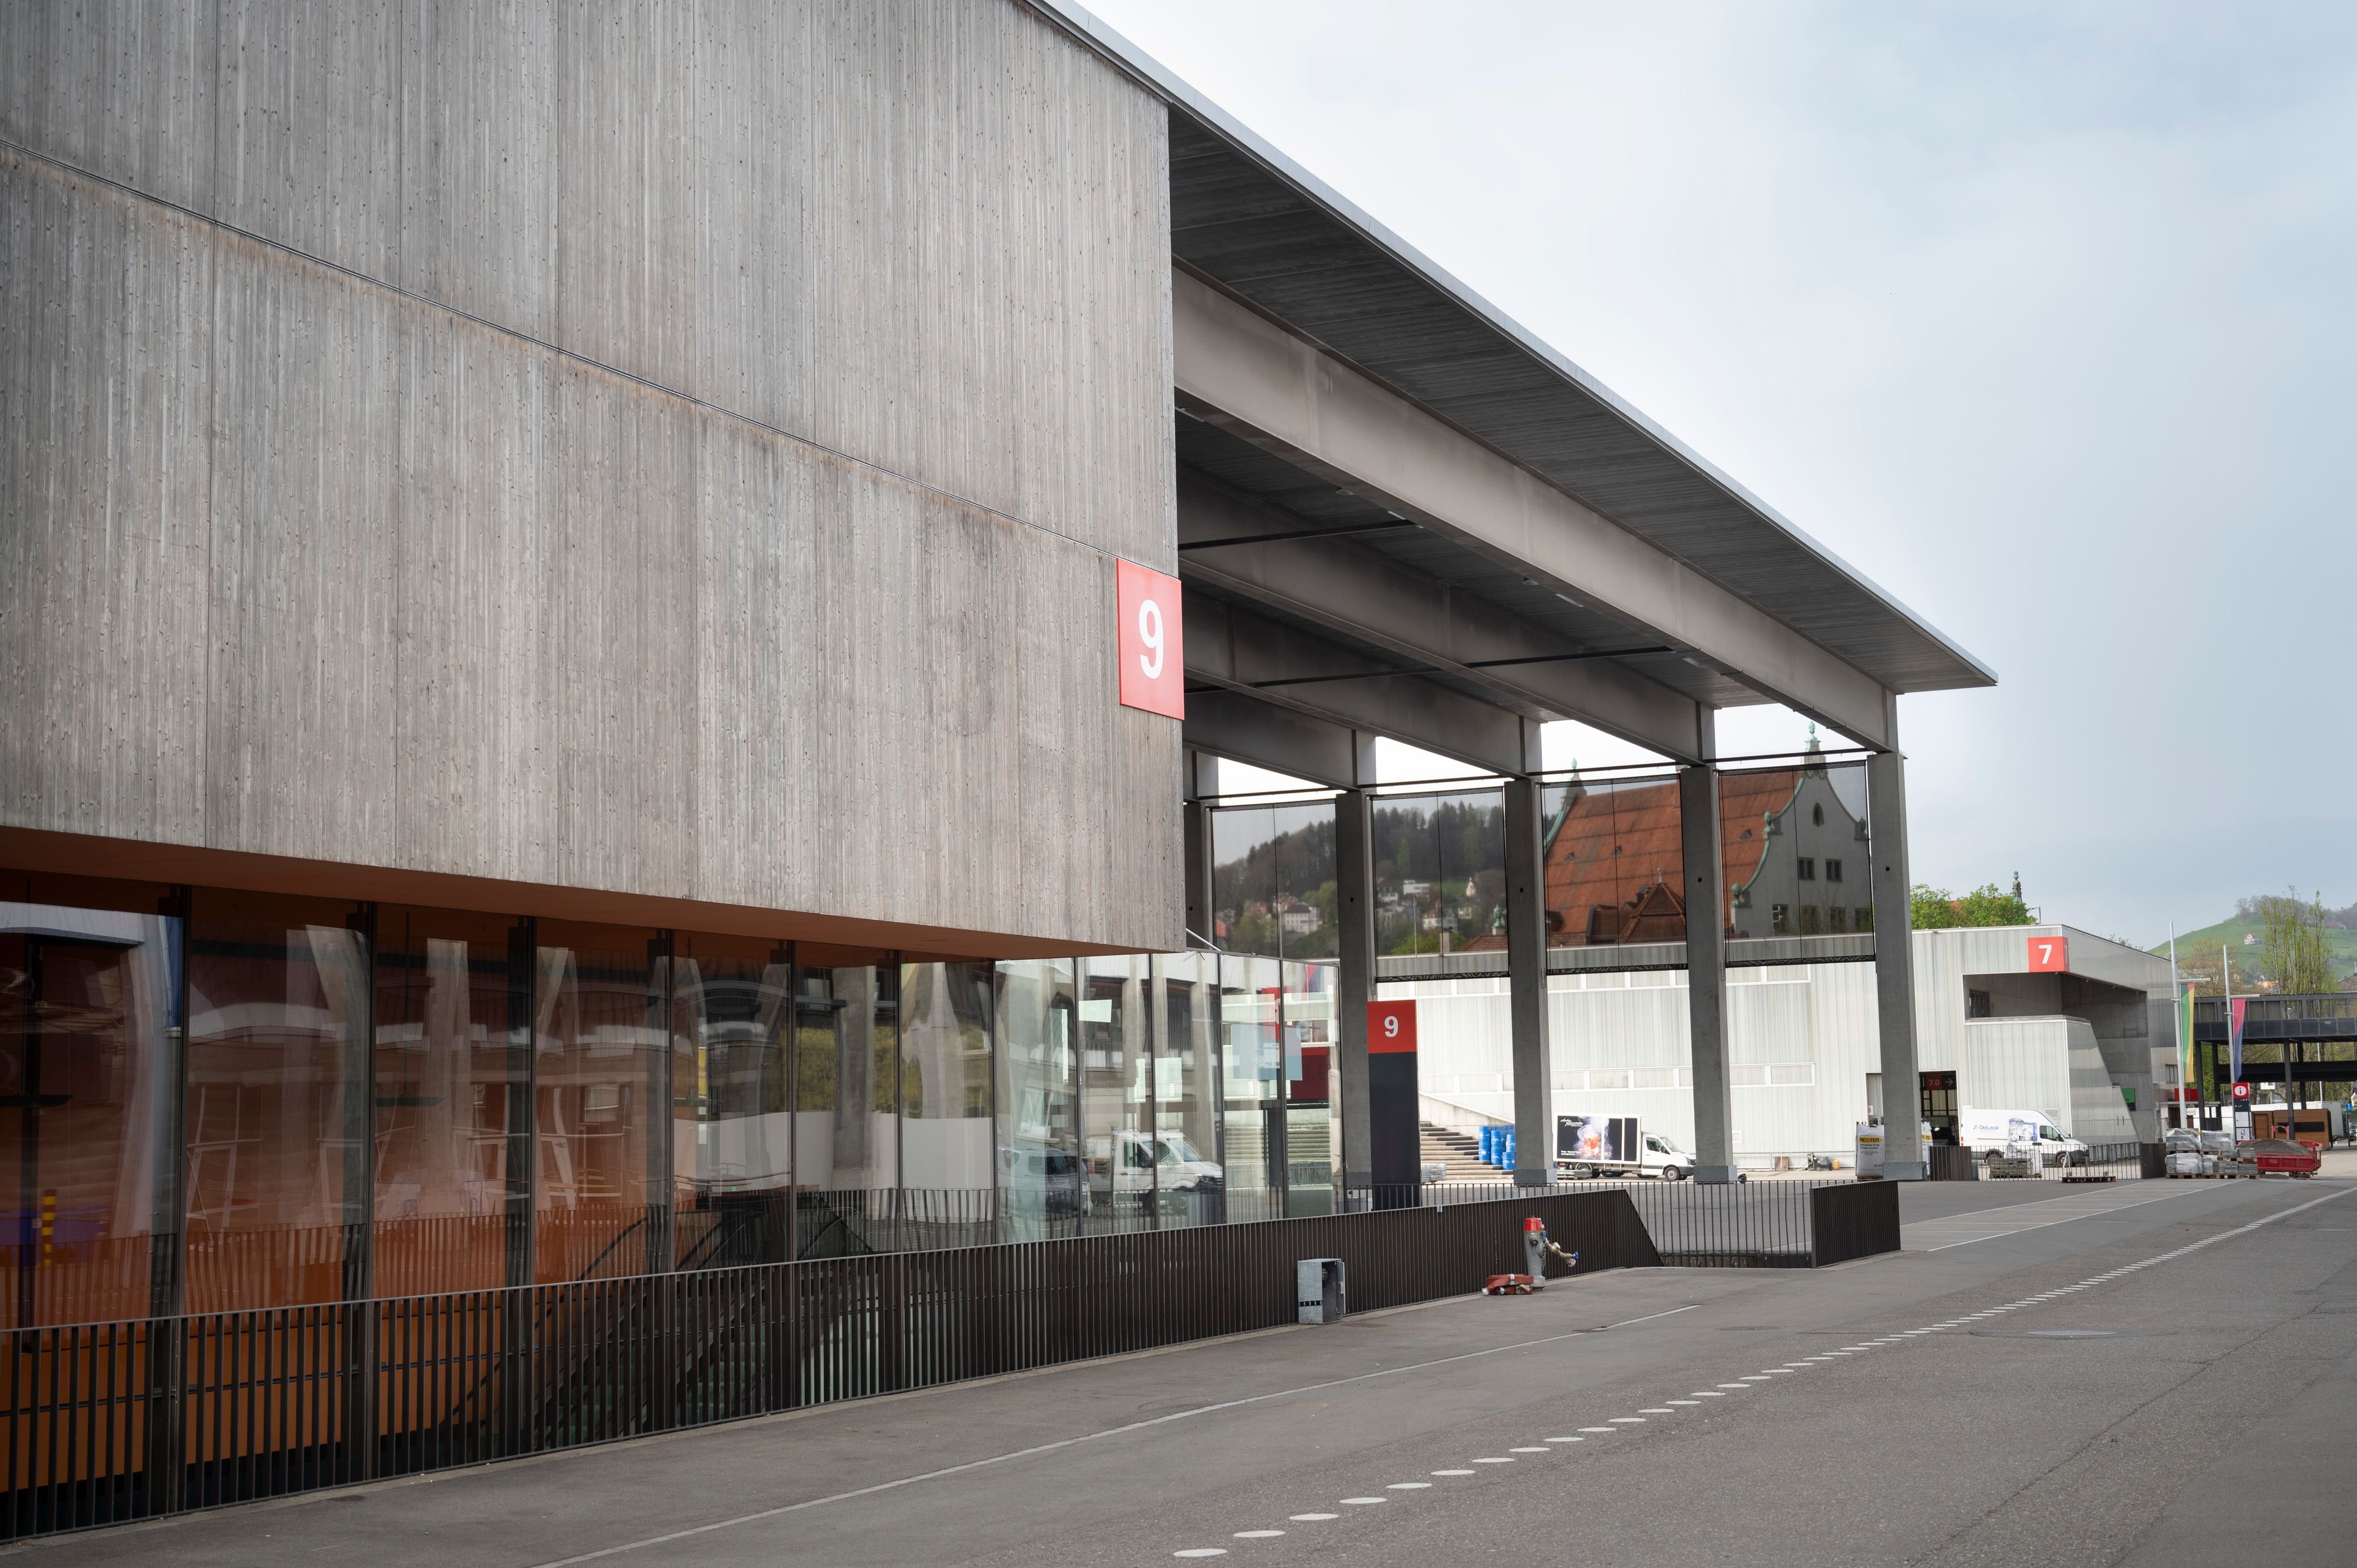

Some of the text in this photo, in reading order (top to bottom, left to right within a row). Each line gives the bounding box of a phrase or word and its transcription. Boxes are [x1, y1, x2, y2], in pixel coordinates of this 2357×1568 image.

[1138, 599, 1164, 679] 9
[2038, 944, 2052, 965] 7
[1384, 1015, 1398, 1038] 9
